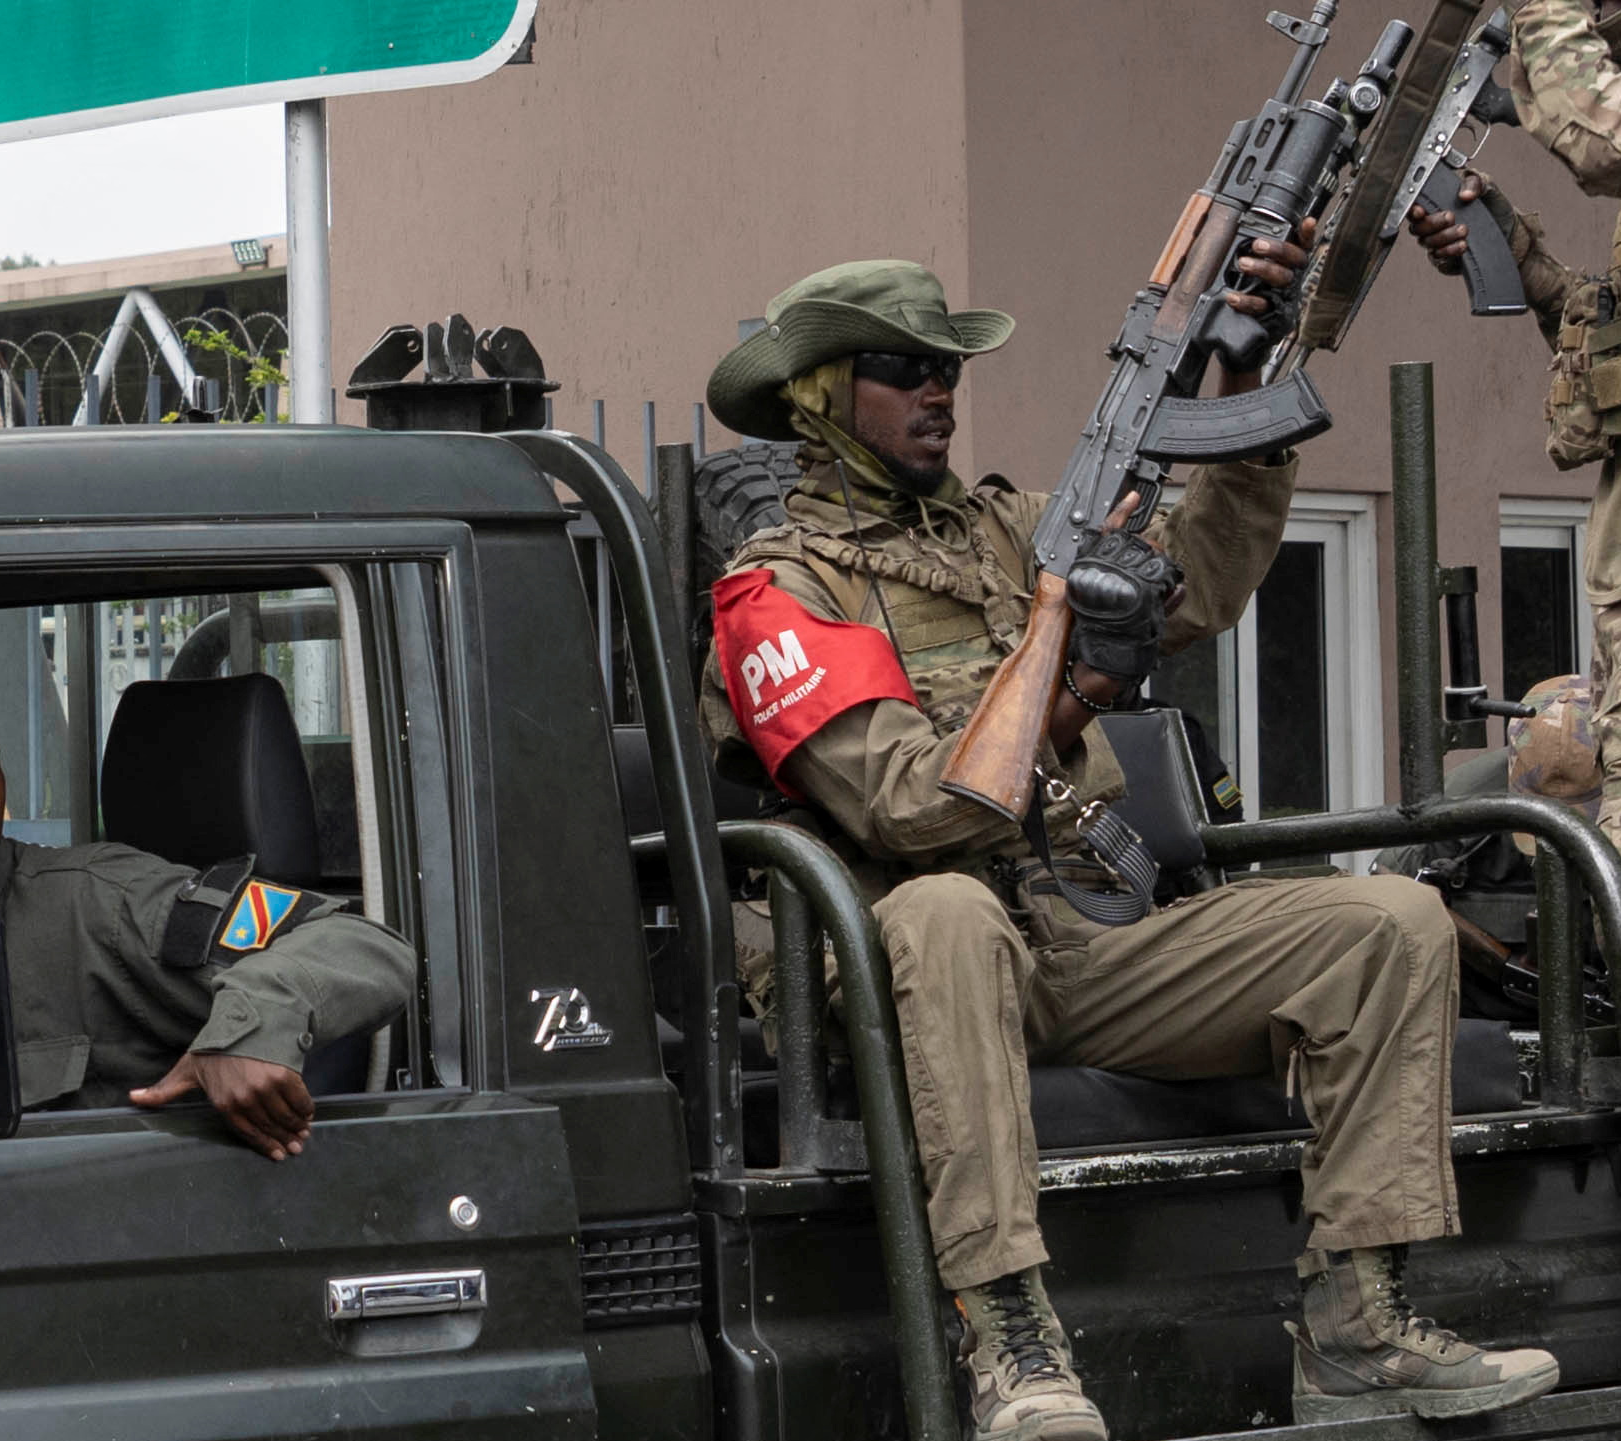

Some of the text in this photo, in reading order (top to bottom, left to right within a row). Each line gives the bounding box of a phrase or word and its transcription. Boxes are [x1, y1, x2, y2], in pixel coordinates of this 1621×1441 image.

[741, 629, 810, 707] PM
[753, 666, 827, 726] POLICE MILITAIRE
